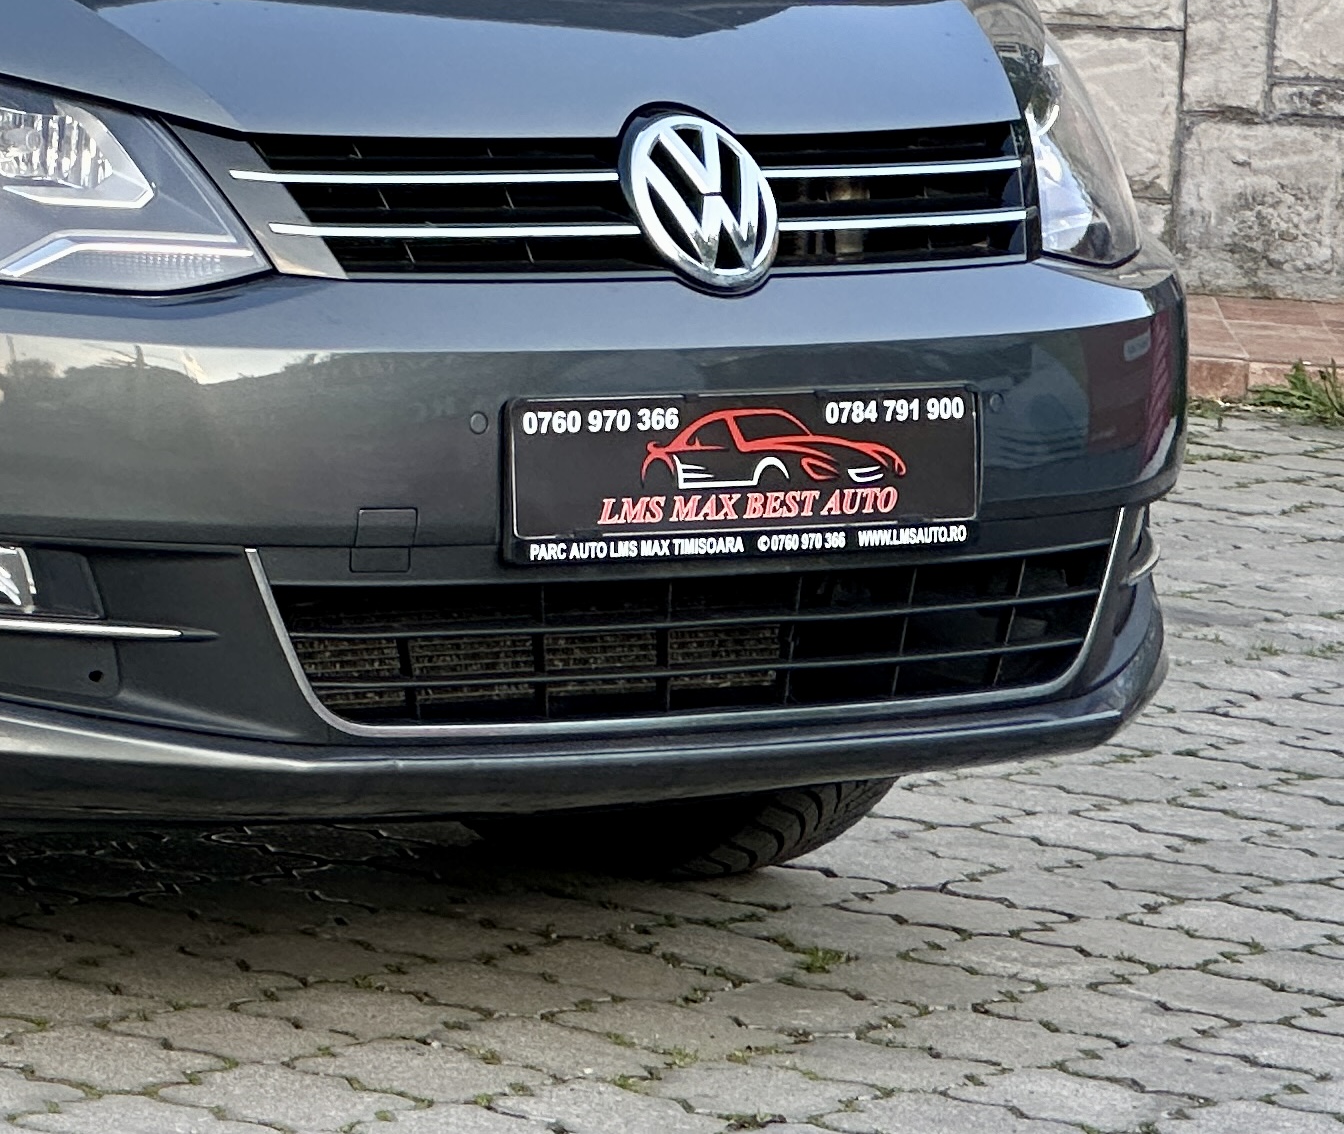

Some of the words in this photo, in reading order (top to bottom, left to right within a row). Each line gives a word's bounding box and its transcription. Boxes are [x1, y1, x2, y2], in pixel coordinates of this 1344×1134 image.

[523, 411, 581, 435] 0760
[588, 409, 631, 433] 970
[637, 407, 679, 432] 366
[825, 401, 878, 425] 0784
[883, 398, 922, 423] 791
[927, 396, 964, 421] 900
[597, 496, 666, 526] LMS
[669, 492, 742, 523] MAX
[743, 489, 819, 519] BEST
[820, 485, 899, 516] AUTO
[530, 543, 567, 561] PARC
[569, 541, 608, 559] AUTO
[610, 540, 638, 557] LMS
[640, 539, 670, 556] MAX
[672, 536, 745, 555] TIMISOARA
[801, 533, 822, 550] 970
[824, 531, 846, 549] 366
[858, 525, 967, 547] WWW.LMSAUTO.RO
